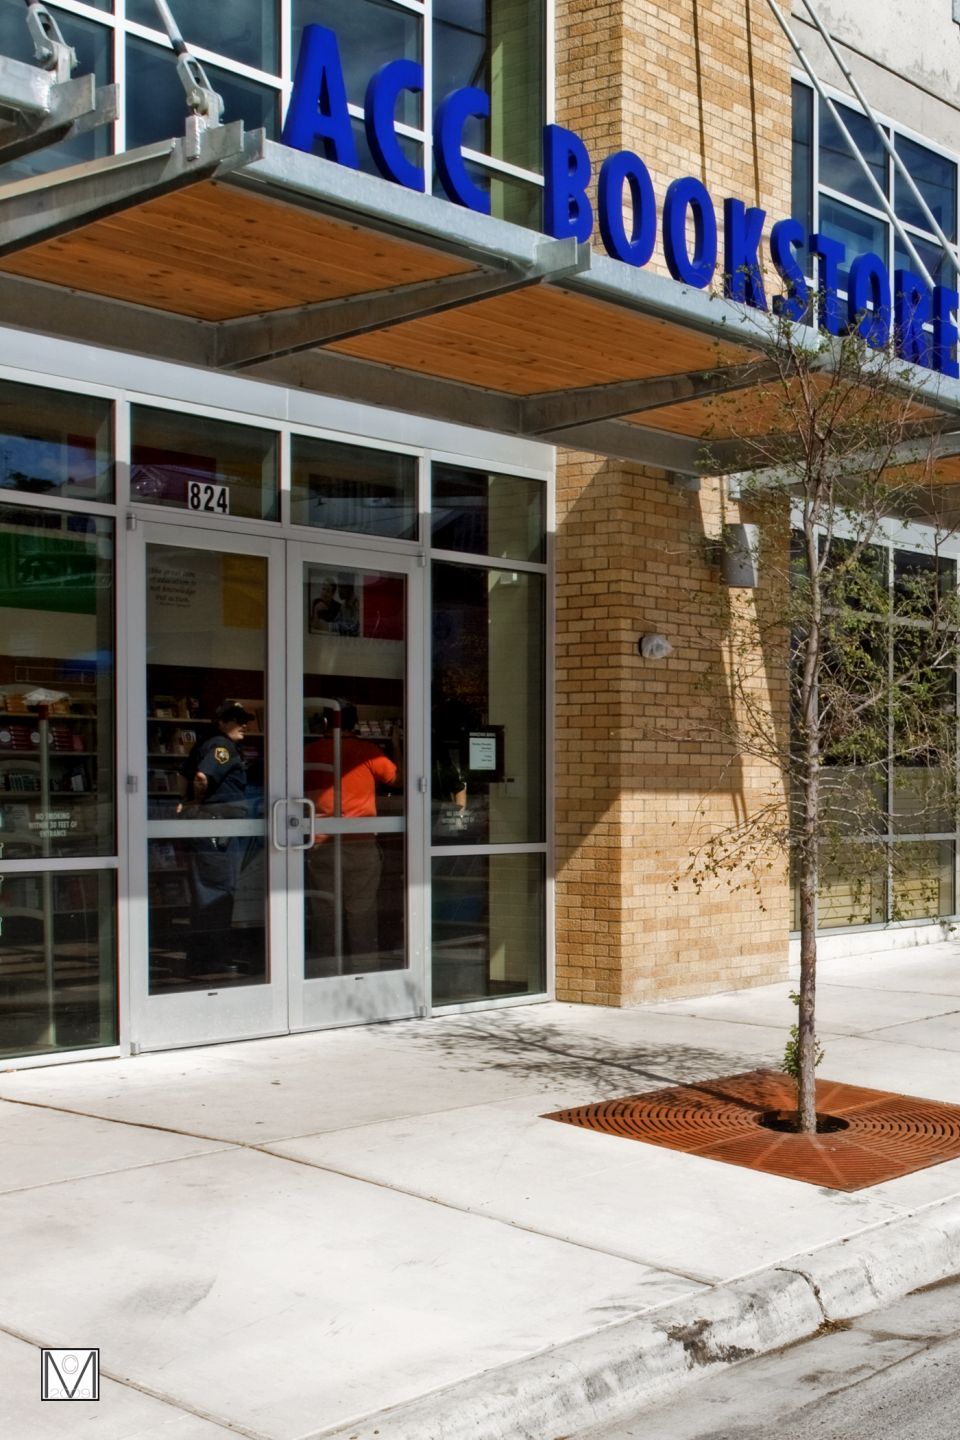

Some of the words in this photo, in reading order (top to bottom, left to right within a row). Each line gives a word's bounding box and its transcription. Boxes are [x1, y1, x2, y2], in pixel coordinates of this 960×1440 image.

[281, 23, 491, 215] ACC
[543, 124, 960, 379] BOOKSTORE
[190, 482, 228, 513] 824
